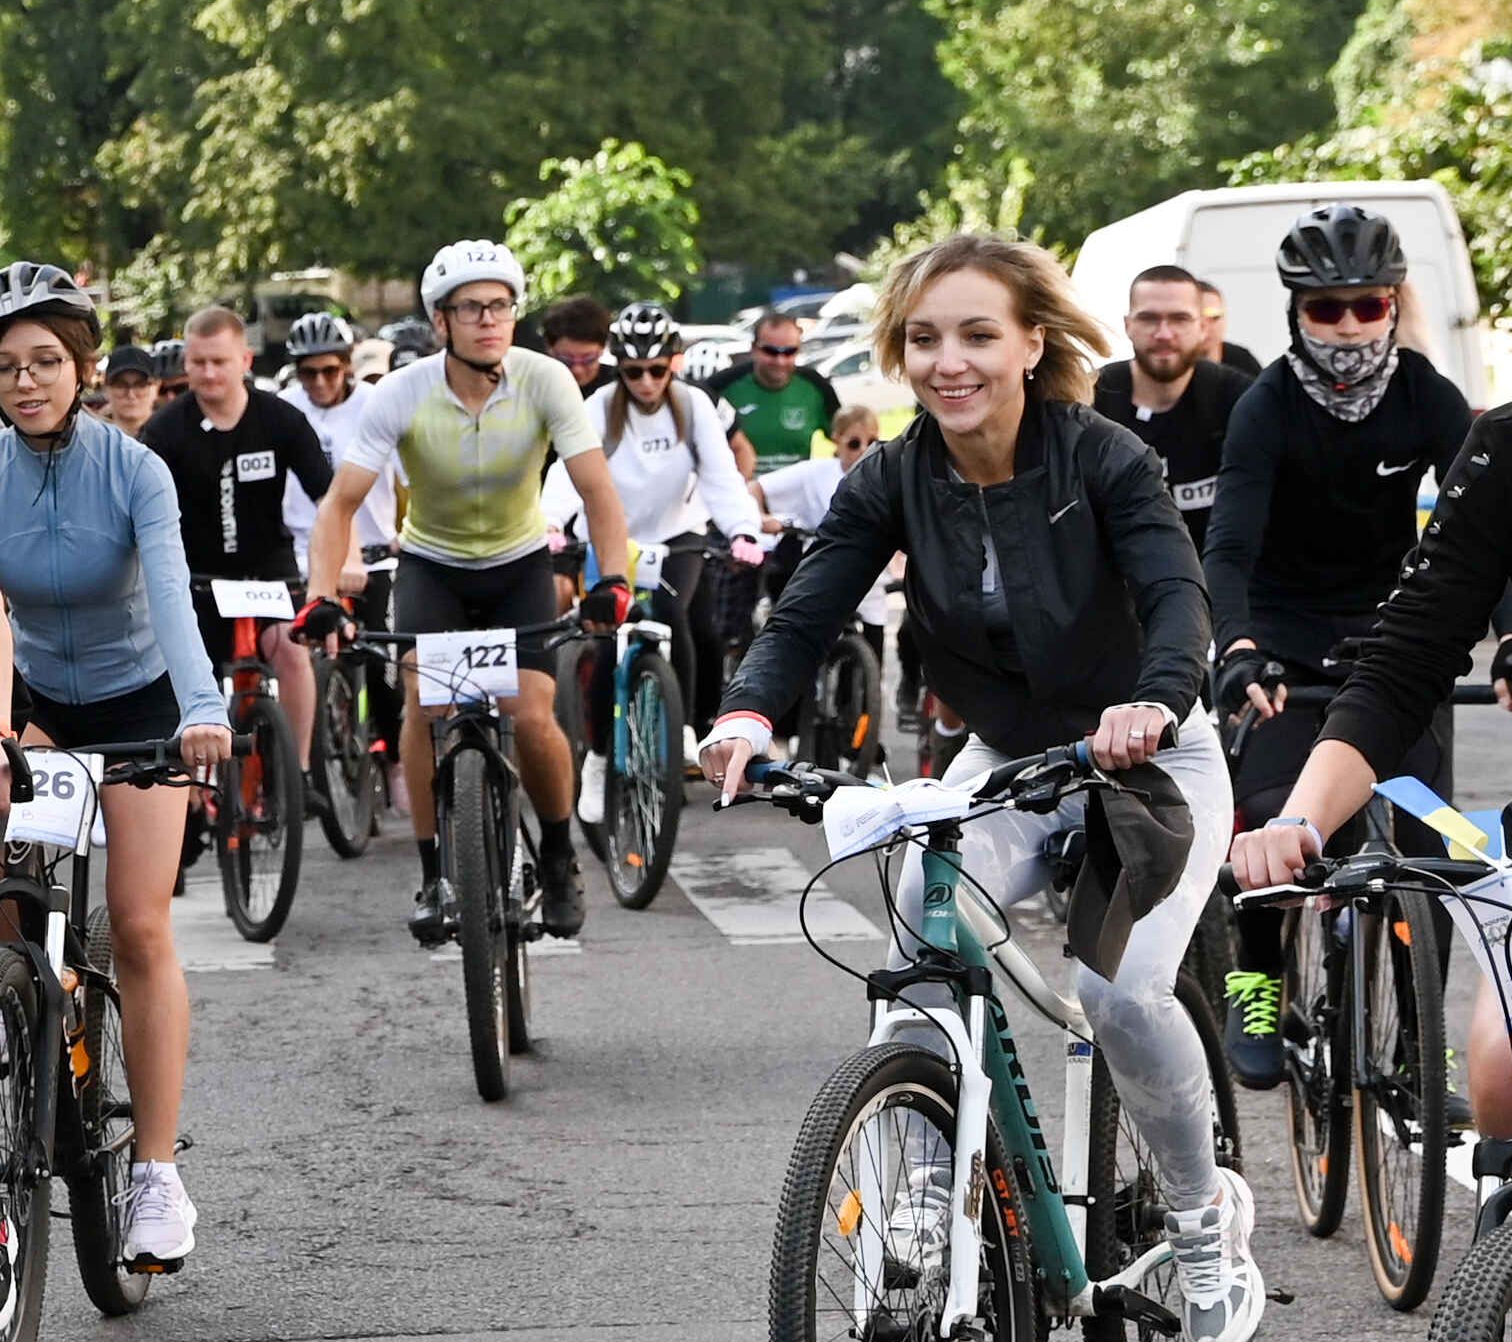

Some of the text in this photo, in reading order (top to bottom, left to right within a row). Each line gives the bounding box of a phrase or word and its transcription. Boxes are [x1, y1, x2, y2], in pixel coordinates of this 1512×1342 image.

[466, 251, 498, 263] 122
[240, 456, 271, 473] 002
[1181, 481, 1215, 502] 017
[245, 590, 286, 602] 002
[461, 644, 509, 670] 122
